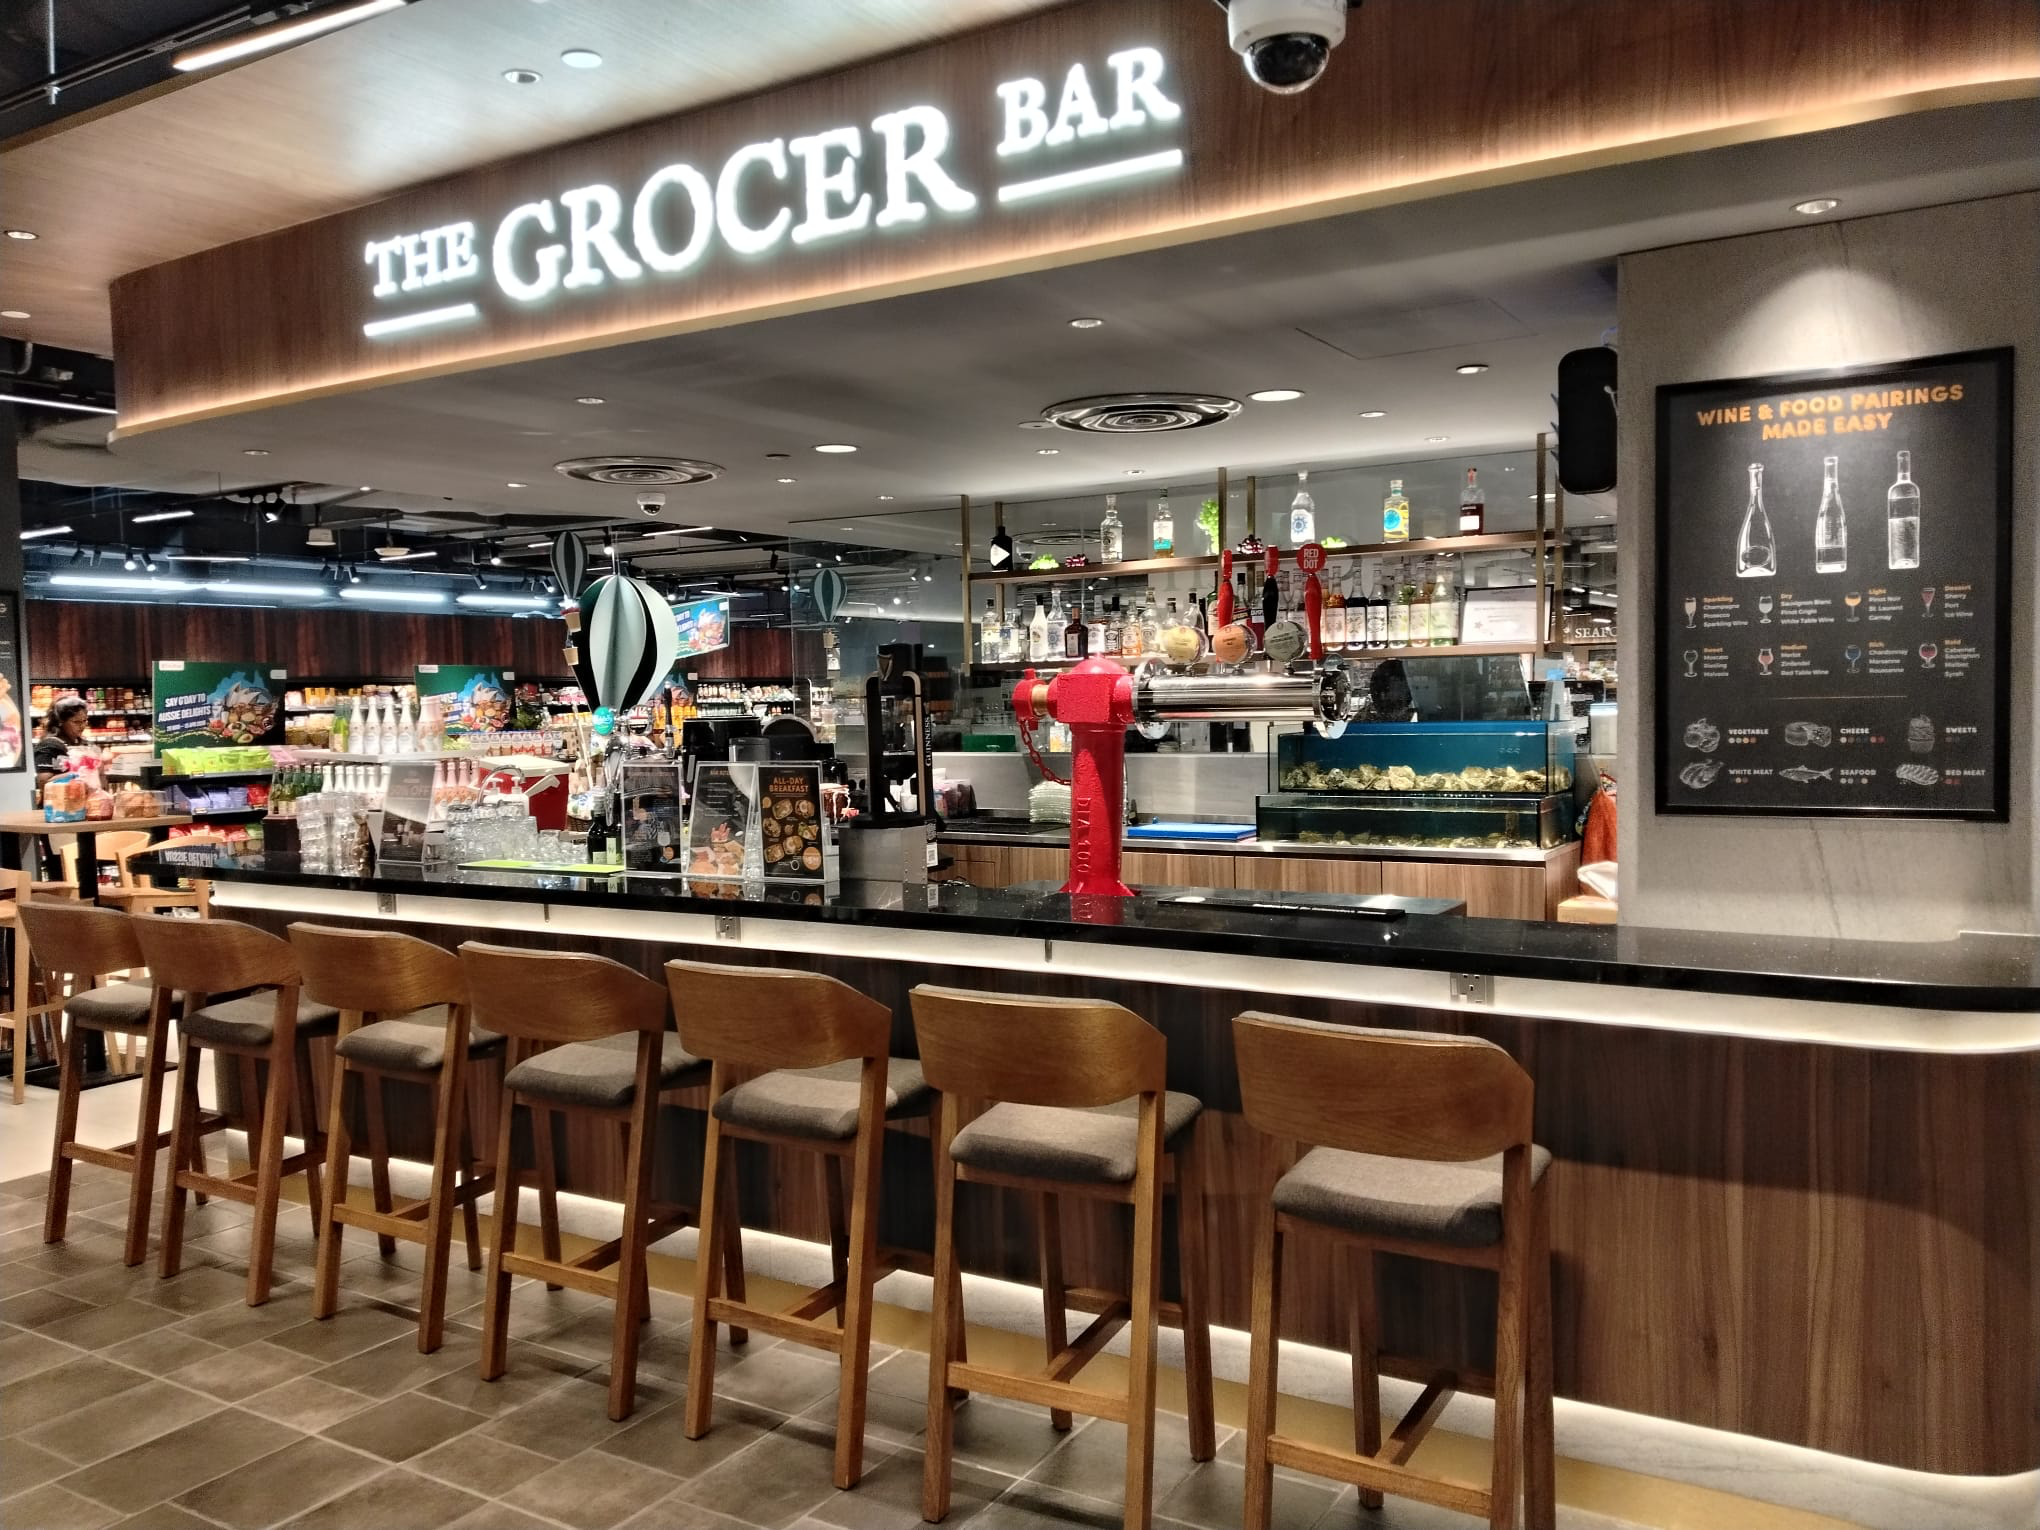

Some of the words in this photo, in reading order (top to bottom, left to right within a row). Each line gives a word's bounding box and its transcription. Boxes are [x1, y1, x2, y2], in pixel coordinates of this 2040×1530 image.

[364, 218, 480, 299] THE
[492, 104, 977, 304] GROCER
[996, 46, 1180, 155] BAR
[1697, 405, 1753, 427] WINE
[1758, 403, 1774, 420] &
[1780, 395, 1845, 419] FOOD
[1852, 384, 1965, 412] PAIRINGS
[1762, 418, 1828, 441] MADE
[1833, 412, 1894, 436] EASY
[1303, 549, 1319, 558] RED
[1303, 559, 1319, 569] DOT
[1780, 593, 1793, 601] Dry
[165, 696, 180, 708] SAY
[198, 693, 206, 703] TO
[158, 710, 182, 723] AUSSIE
[181, 705, 212, 719] DELIGHTS
[1728, 728, 1769, 736] VEGETABLE
[1840, 727, 1870, 735] CHEESE
[1946, 726, 1978, 734] SWEETS
[924, 717, 932, 767] GUINNESS
[1728, 768, 1752, 776] WHITE
[1754, 768, 1774, 776] MEAT
[1963, 769, 1986, 777] MEAT
[773, 776, 805, 785] ALL-DAY
[768, 784, 809, 793] BREAKFAST
[1076, 840, 1092, 873] 100
